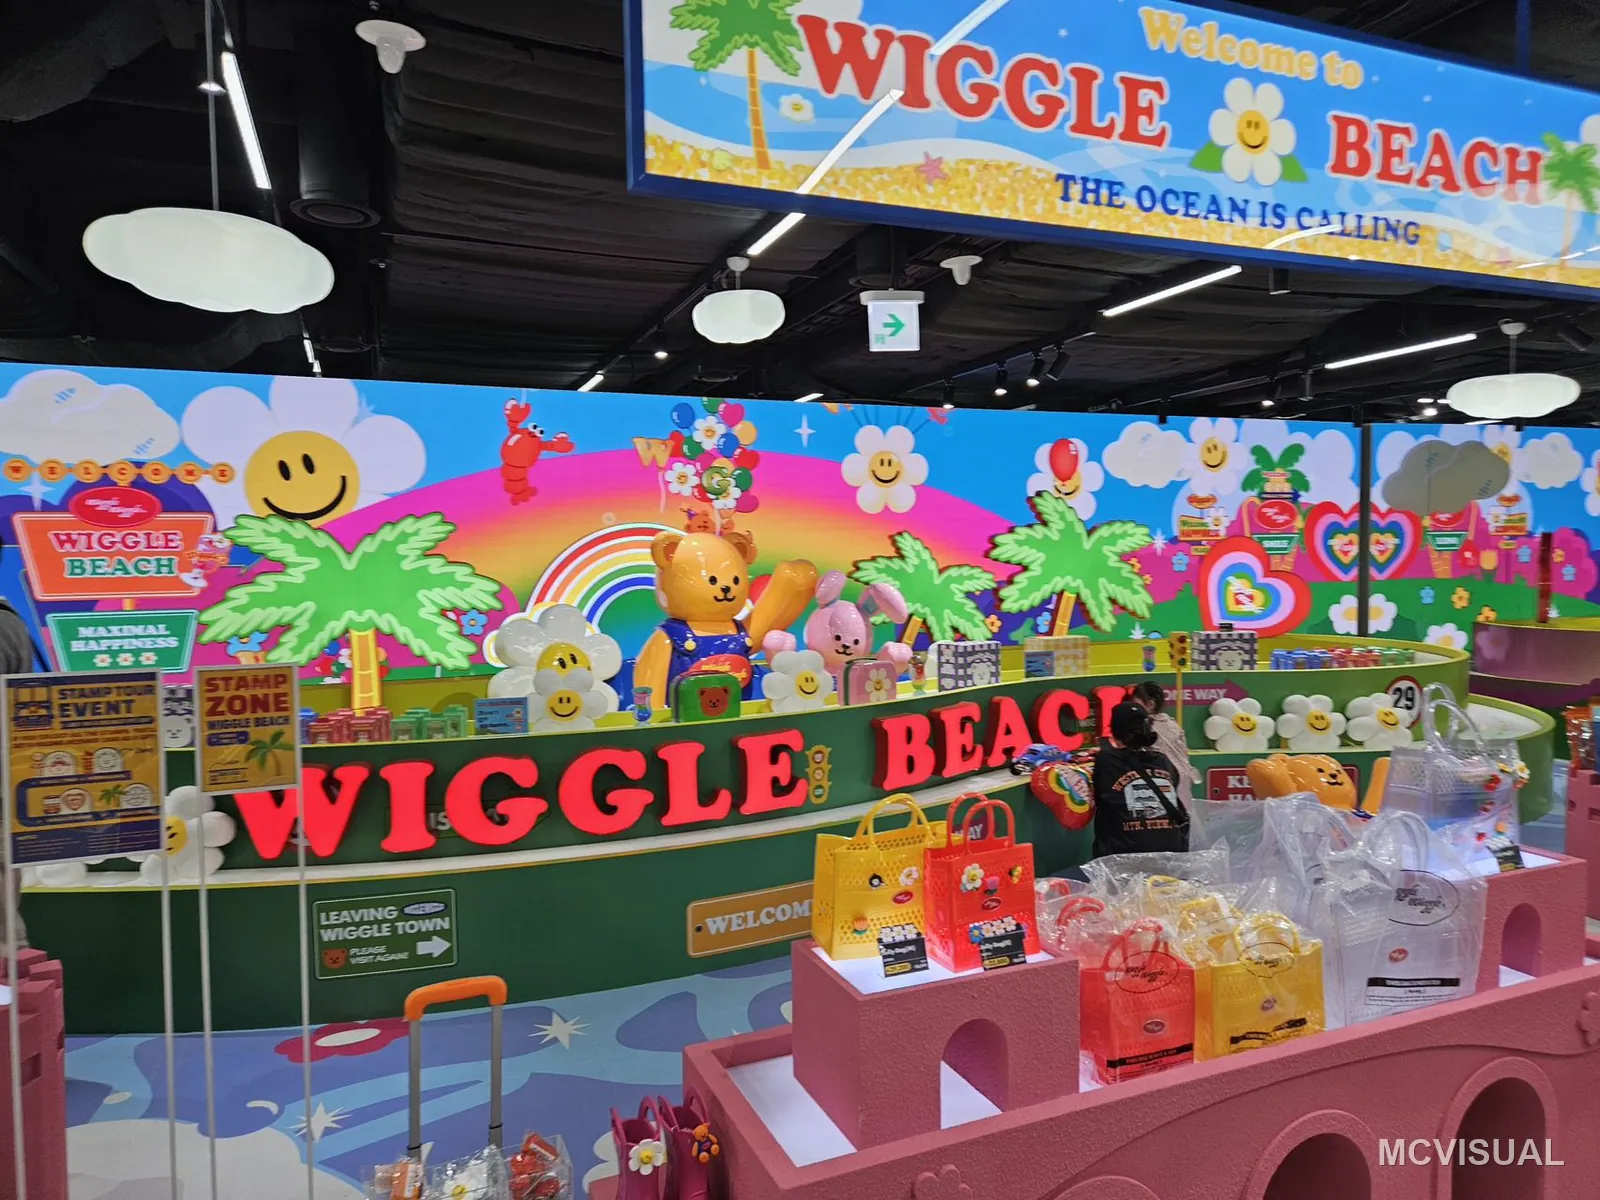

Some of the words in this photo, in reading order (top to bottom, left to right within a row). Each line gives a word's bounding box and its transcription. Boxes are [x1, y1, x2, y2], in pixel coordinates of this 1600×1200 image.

[1139, 7, 1316, 81] Welcome
[1323, 51, 1363, 89] to
[797, 14, 1169, 148] WIGGLE
[1328, 112, 1544, 205] BEACH
[1055, 173, 1125, 209] THE
[1135, 184, 1248, 224] OCEAN
[1259, 200, 1287, 230] IS
[1294, 207, 1421, 246] CALLING
[49, 531, 184, 551] WIGGLE
[65, 556, 178, 578] BEACH
[70, 637, 179, 652] HAPPINESS
[205, 673, 287, 693] STAMP
[206, 692, 290, 717] ZONE
[1193, 688, 1227, 701] WAY
[1393, 686, 1414, 711] 29
[59, 699, 136, 718] EVENT
[232, 729, 808, 859] WIGGLE
[320, 905, 398, 925] LEAVING
[319, 923, 392, 942] WIGGLE
[395, 917, 450, 935] TOWN
[349, 945, 387, 956] PLEASE
[350, 953, 375, 965] VISIT
